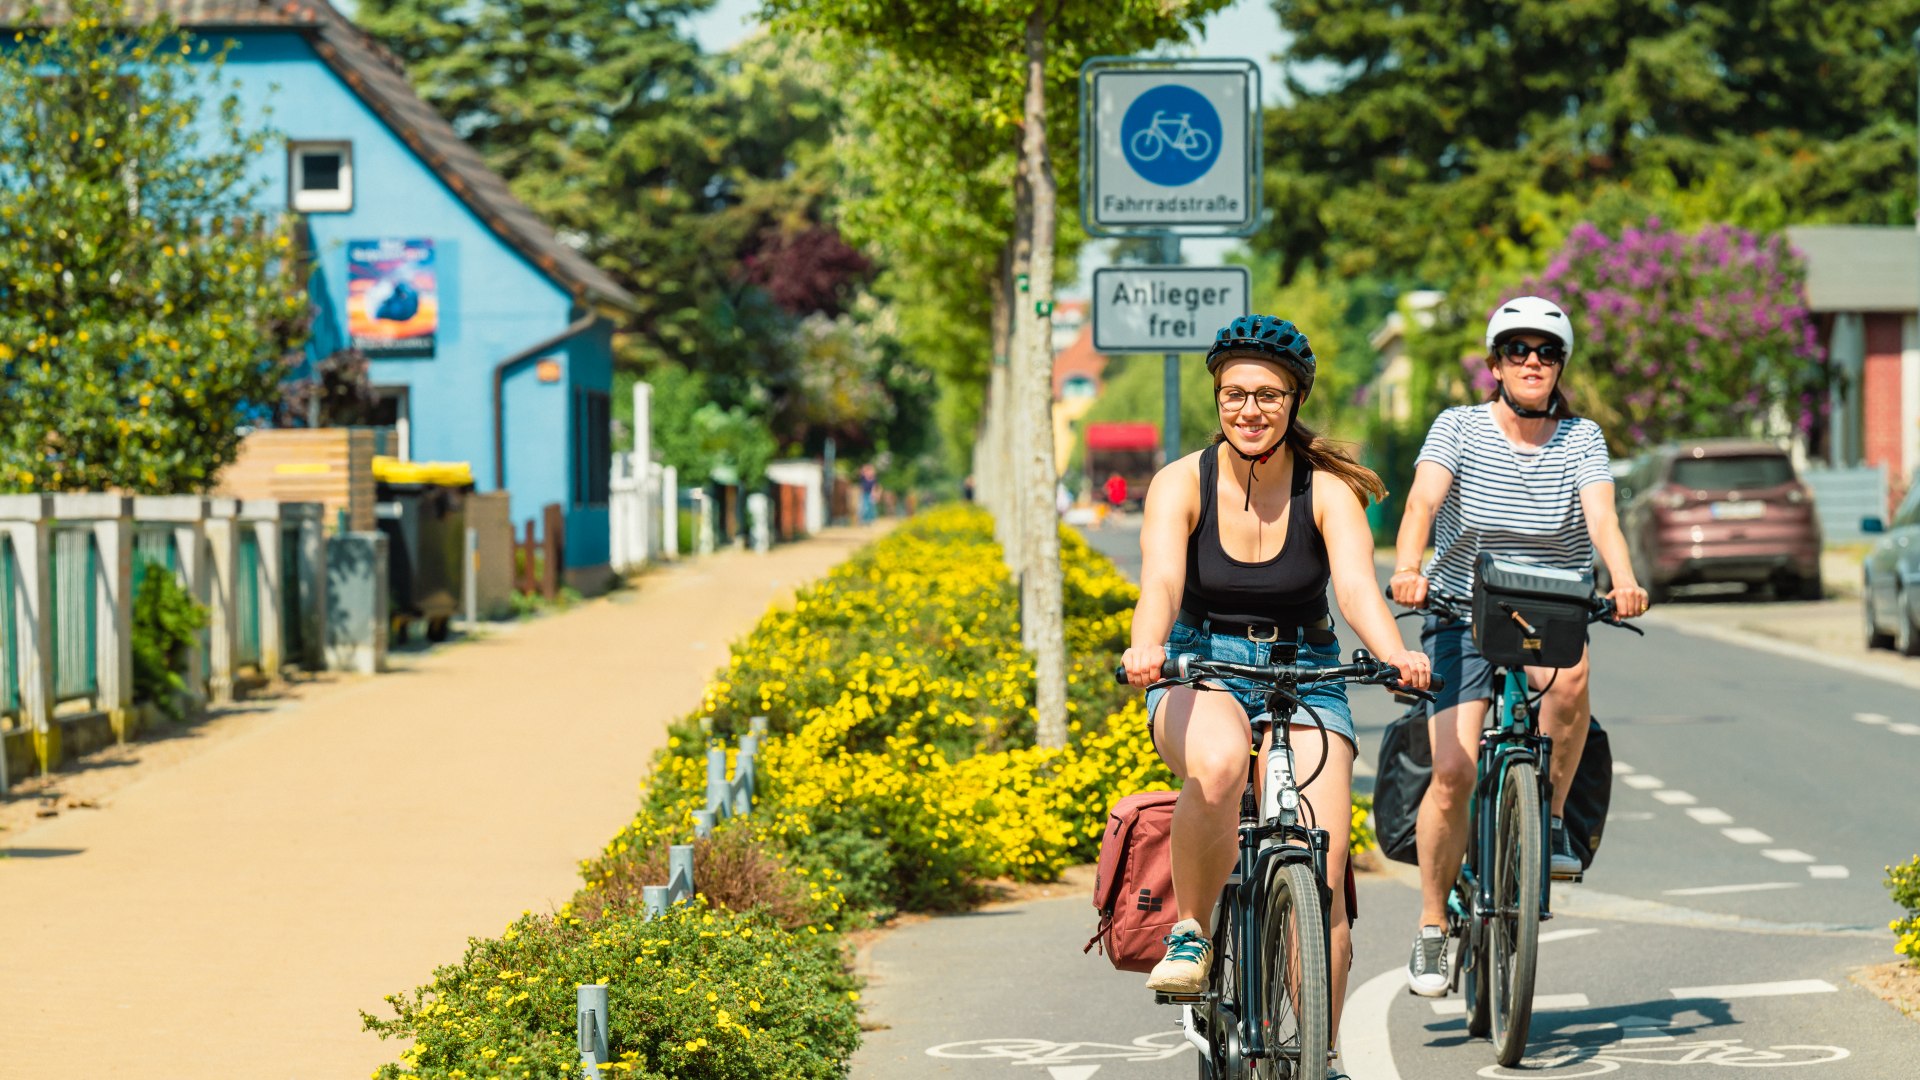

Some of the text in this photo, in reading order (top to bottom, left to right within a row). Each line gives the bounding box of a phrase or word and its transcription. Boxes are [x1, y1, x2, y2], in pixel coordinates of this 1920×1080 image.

[1104, 196, 1238, 213] Fahrradstraße
[1113, 282, 1230, 311] Anlieger
[1150, 313, 1196, 337] frei
